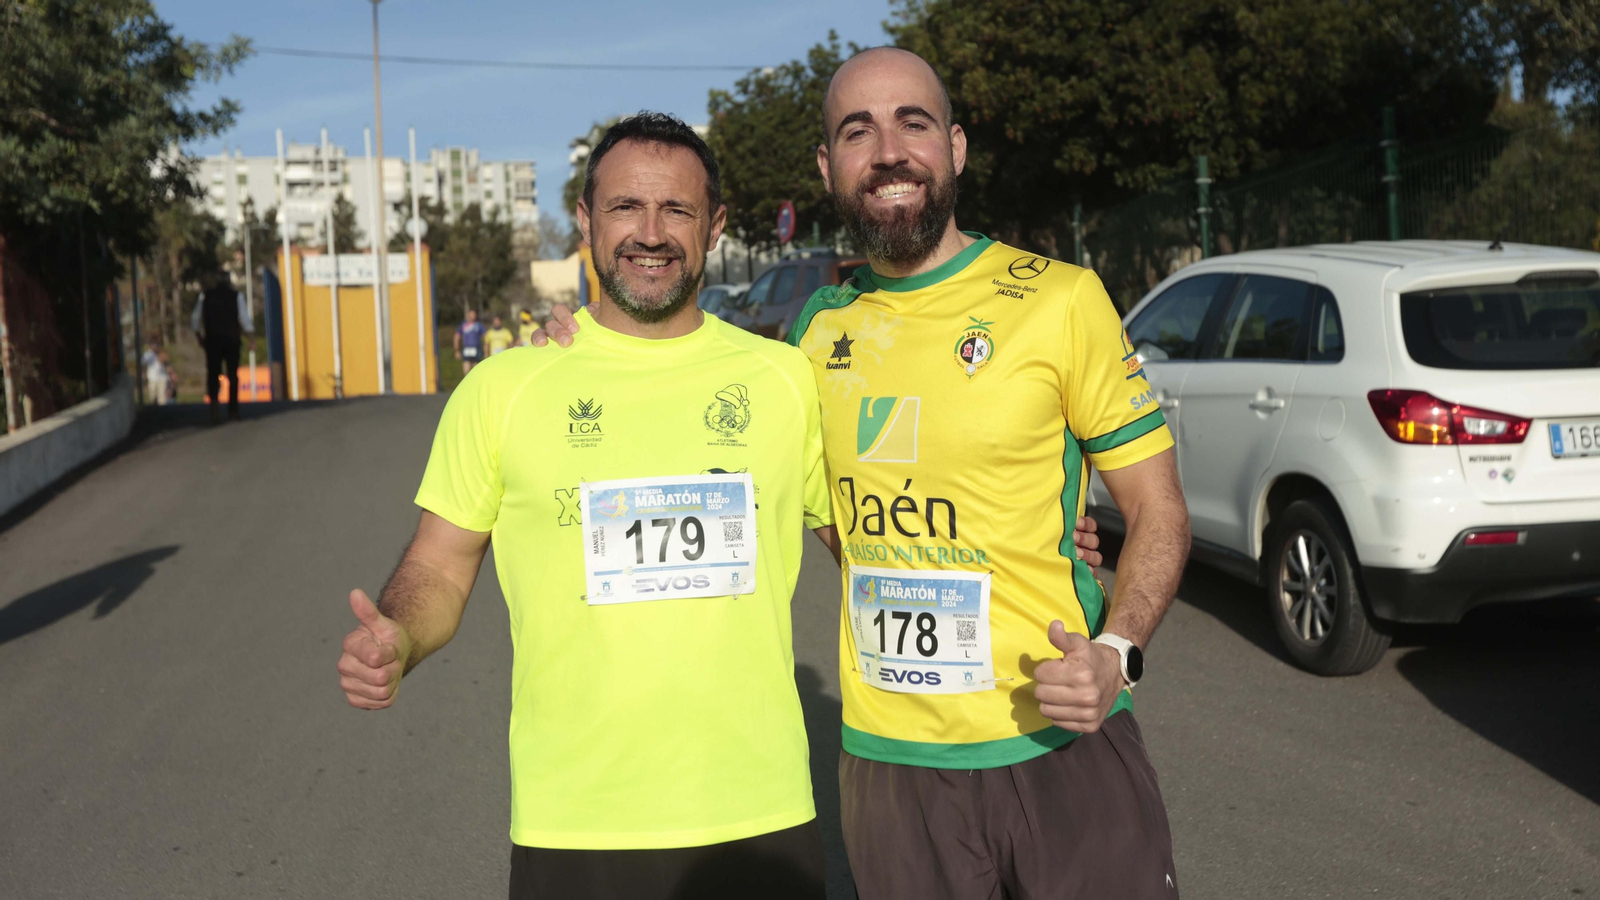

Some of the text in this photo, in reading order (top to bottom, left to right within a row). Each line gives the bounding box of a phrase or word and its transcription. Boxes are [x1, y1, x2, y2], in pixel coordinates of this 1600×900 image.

[991, 279, 1038, 293] Mercedes-Benz
[995, 288, 1024, 300] JADISA
[966, 331, 989, 339] JAEN
[826, 360, 851, 370] luanvi
[568, 422, 602, 434] UCA
[634, 489, 702, 508] MARATÓN
[838, 477, 957, 540] Jaén
[625, 516, 706, 564] 179
[732, 550, 738, 558] L
[891, 544, 991, 565] INTERIOR
[631, 574, 710, 593] EVOS
[881, 584, 937, 600] MARATÓN
[873, 609, 938, 657] 178
[965, 650, 970, 658] L
[878, 667, 942, 686] EVOS
